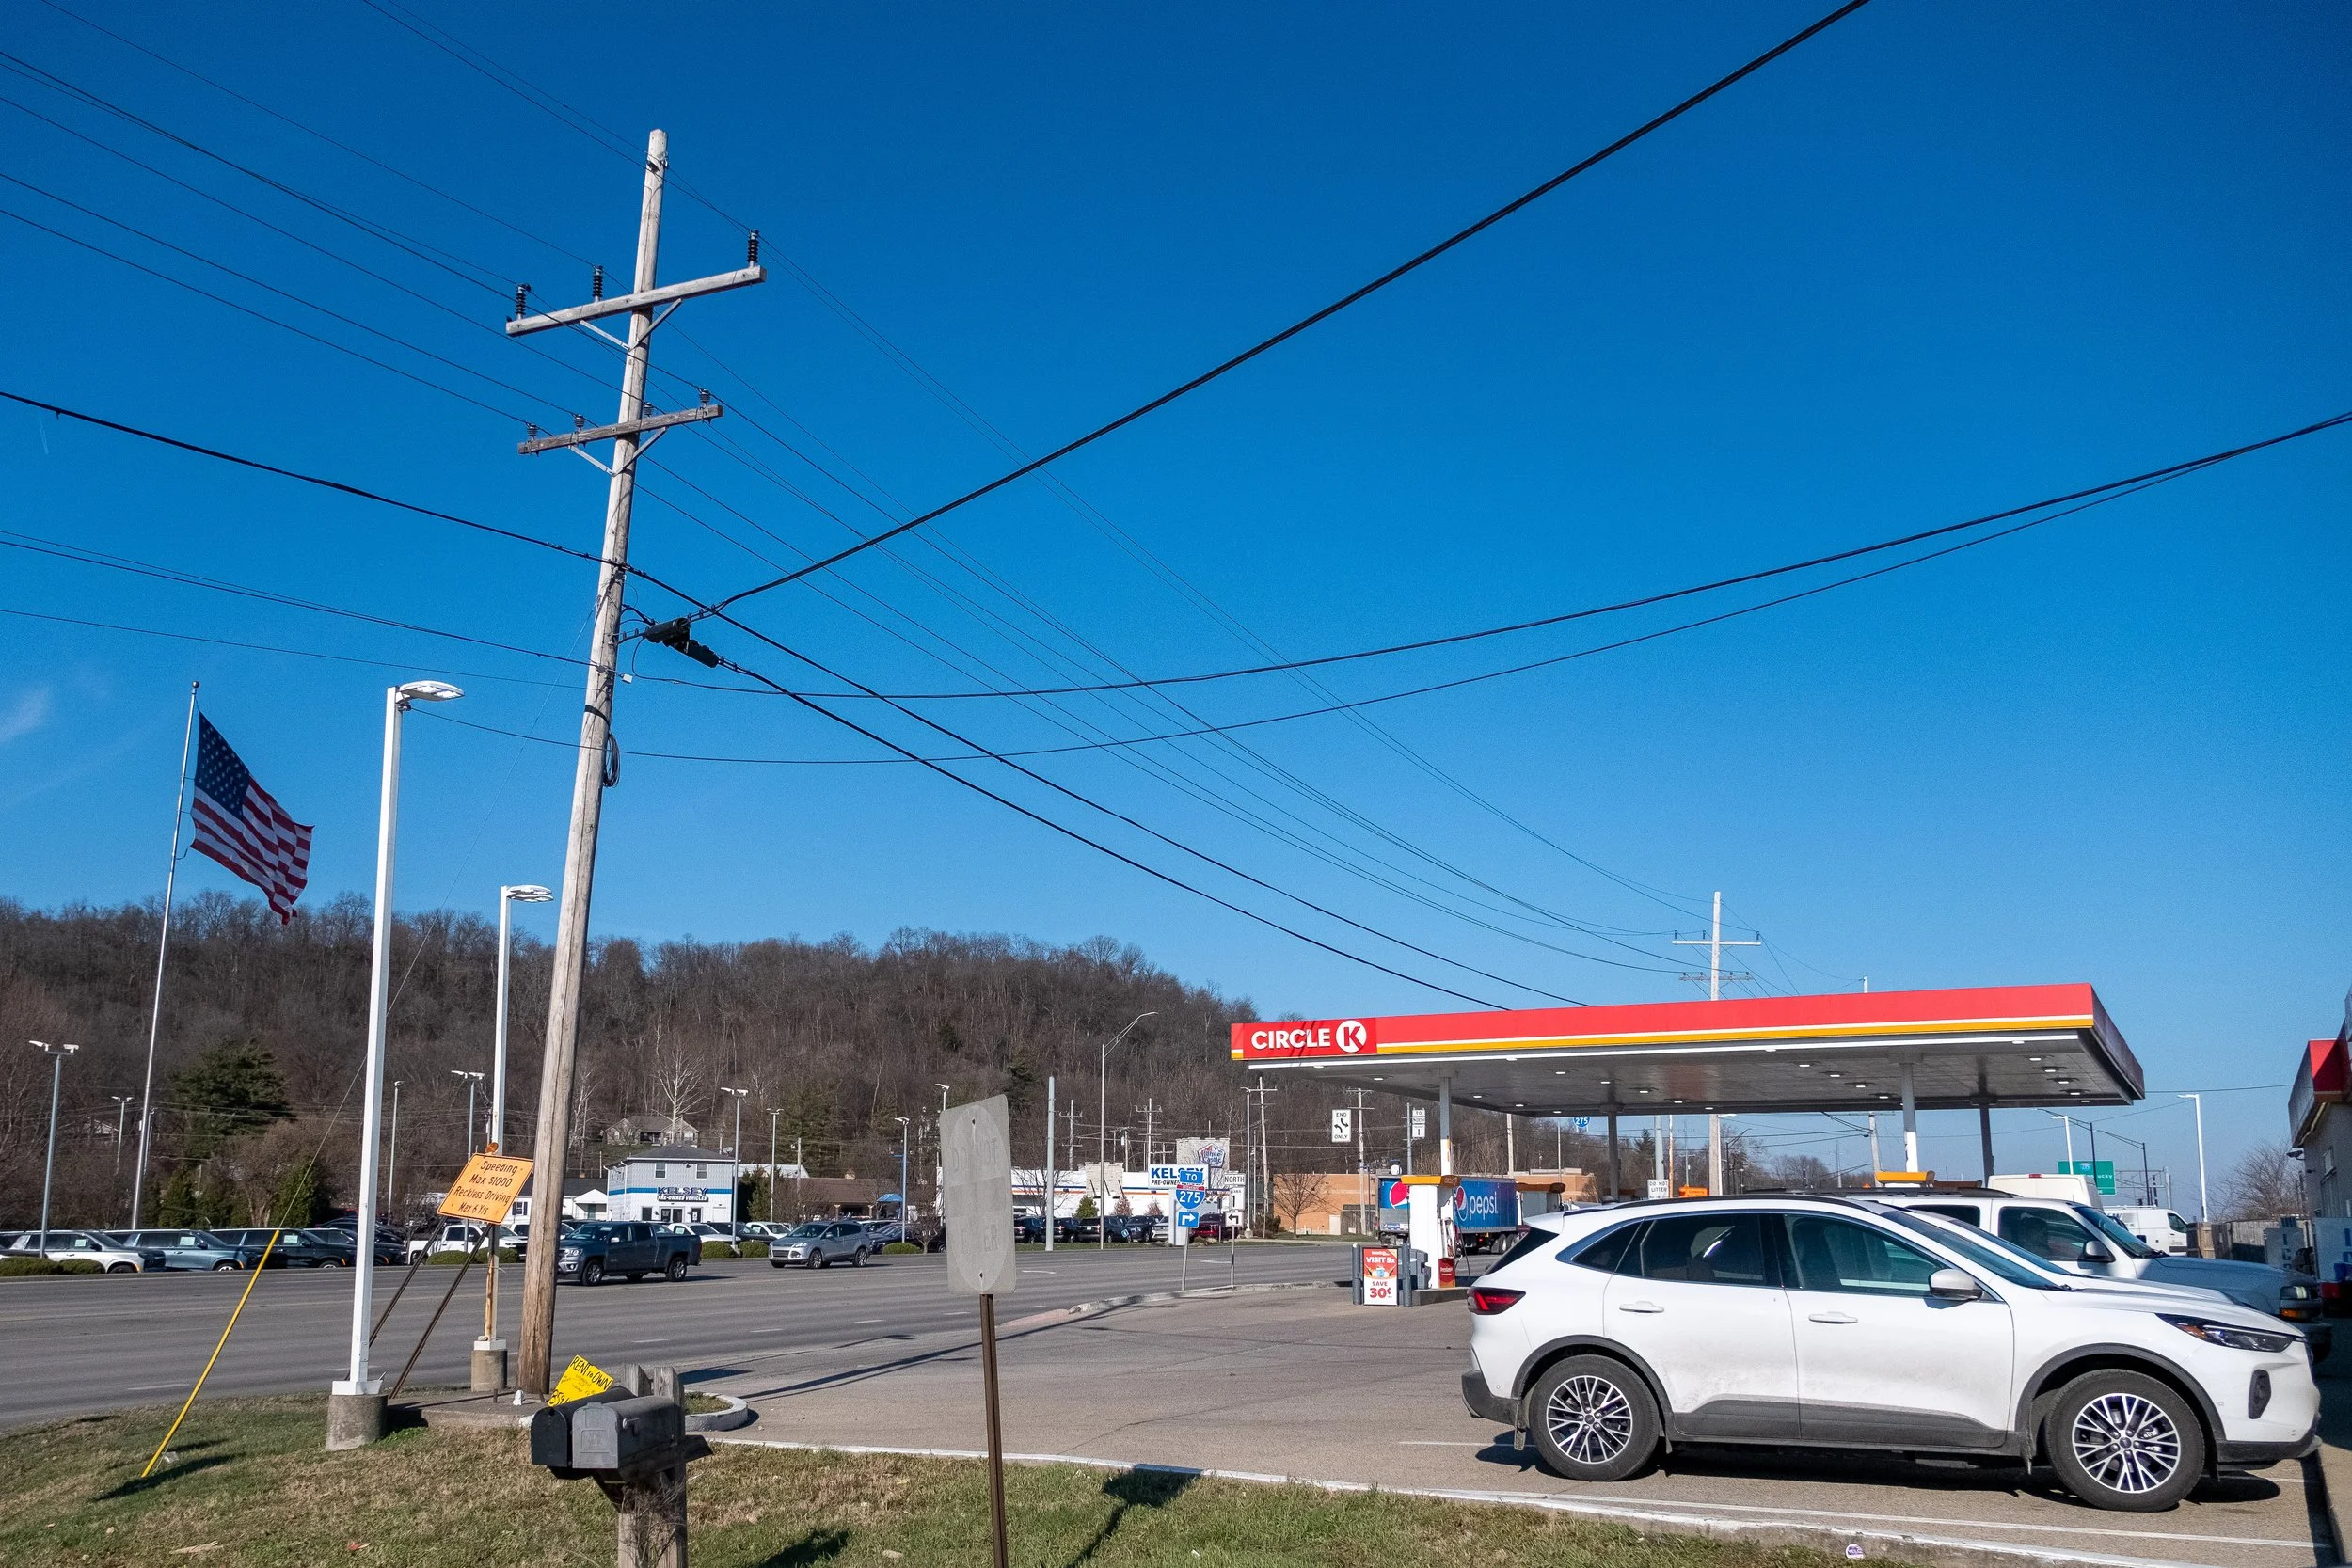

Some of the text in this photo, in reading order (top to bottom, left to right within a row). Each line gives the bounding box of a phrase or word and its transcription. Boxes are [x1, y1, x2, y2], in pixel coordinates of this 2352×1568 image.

[1250, 1024, 1366, 1053] CIRCLE K
[1576, 1117, 1588, 1125] 275
[480, 1161, 518, 1177] Speeding
[469, 1173, 513, 1188] Max $1000
[1185, 1173, 1198, 1181] TO
[1224, 1176, 1245, 1184] NORTH
[453, 1185, 512, 1207] Reckless Driving
[658, 1186, 709, 1196] KELSEY
[1179, 1191, 1201, 1204] 275
[457, 1202, 489, 1215] Max 6 Yrs
[1469, 1191, 1498, 1221] pepsi
[569, 1355, 592, 1376] RENT
[591, 1370, 612, 1391] OWN
